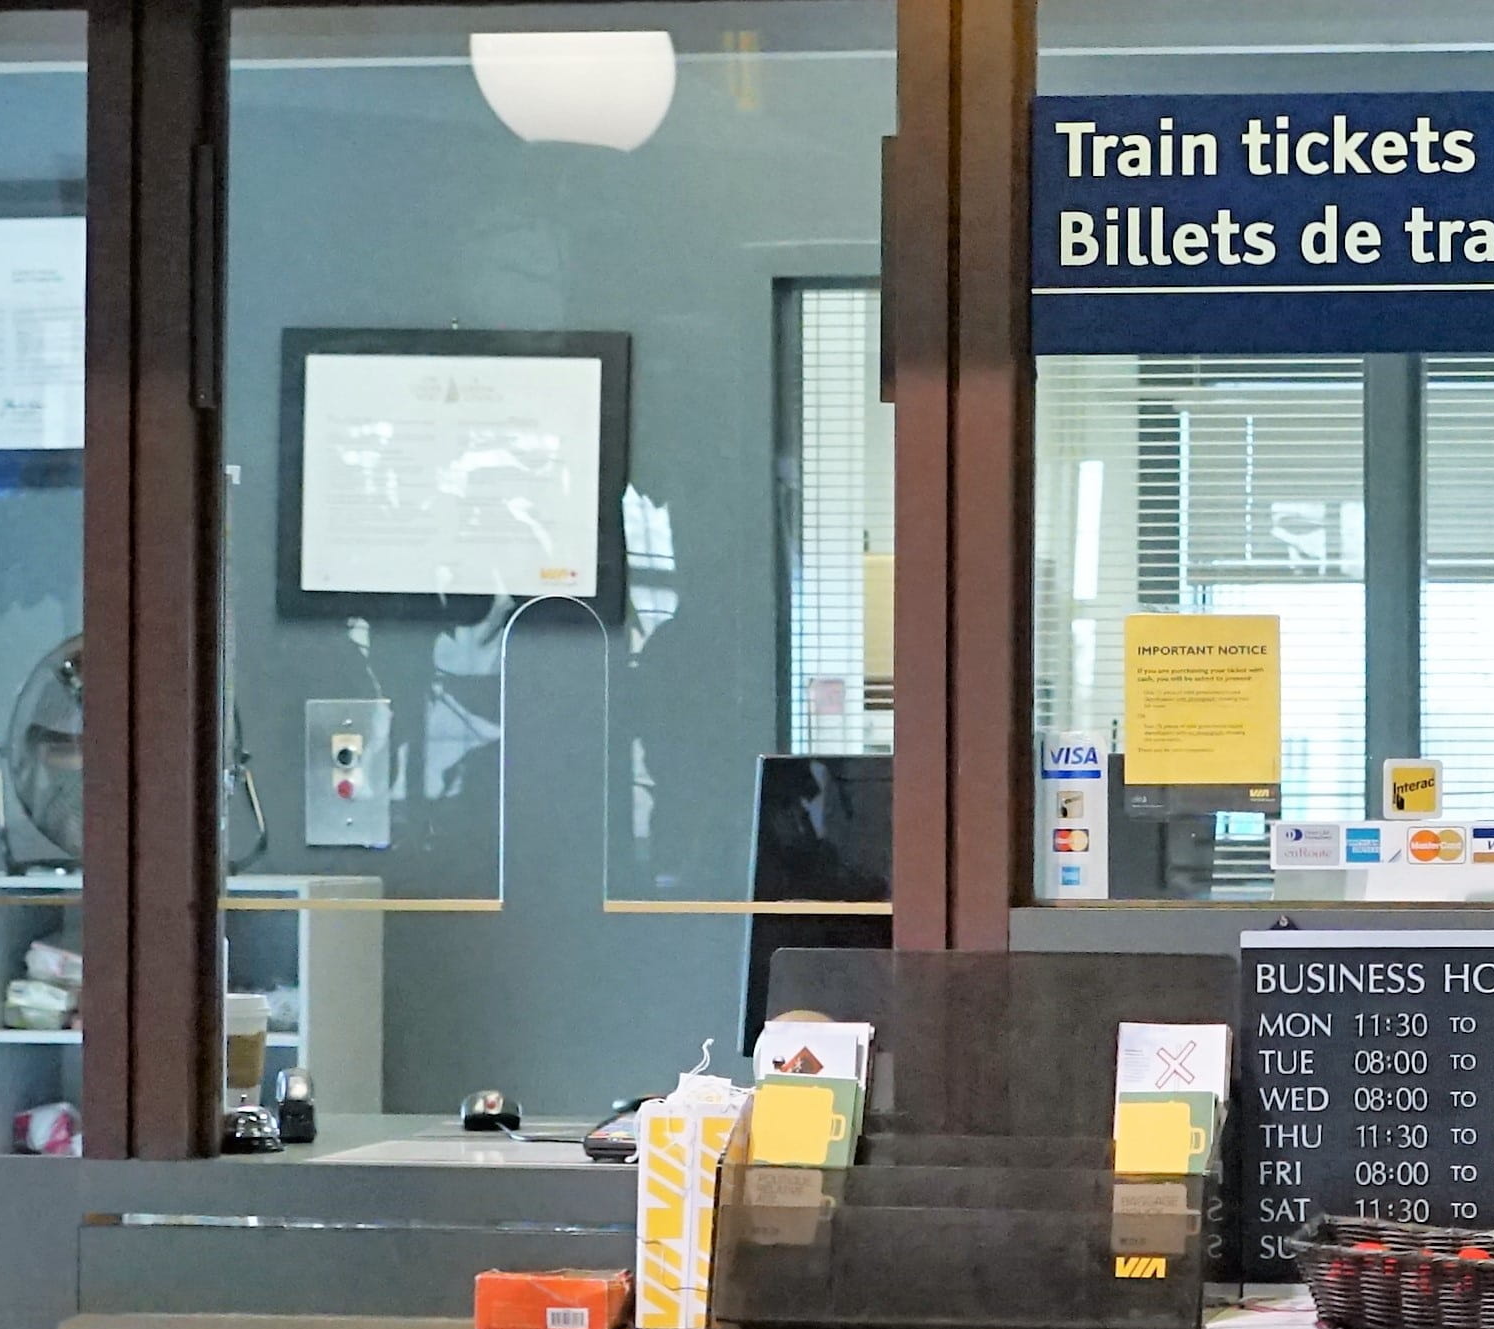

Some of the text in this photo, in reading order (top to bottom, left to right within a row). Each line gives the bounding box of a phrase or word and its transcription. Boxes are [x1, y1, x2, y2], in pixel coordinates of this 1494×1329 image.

[1056, 115, 1477, 177] Train tickets
[1059, 206, 1277, 267] Billets
[1301, 205, 1382, 265] de
[1137, 645, 1268, 656] IMPORTANT NOTICE
[1049, 747, 1099, 765] VISA
[1393, 776, 1435, 796] Interac
[1255, 963, 1426, 995] BUSINESS
[1258, 1012, 1333, 1038] MON
[1354, 1012, 1428, 1038] 11:30
[1450, 1016, 1477, 1034] TO
[1259, 1049, 1314, 1075] TUE
[1354, 1049, 1428, 1075] 08:00
[1450, 1053, 1477, 1071] TO
[1259, 1087, 1330, 1113] WED
[1353, 1087, 1428, 1113] 08:00
[1450, 1091, 1477, 1109] TO
[1259, 1124, 1324, 1150] THU
[1355, 1124, 1428, 1150] 11:30
[1450, 1128, 1477, 1146] TO
[1259, 1161, 1302, 1187] FRI
[1355, 1161, 1429, 1187] 08:00
[1450, 1165, 1477, 1183] TO
[1259, 1198, 1311, 1224] SAT
[1355, 1198, 1430, 1223] 11:30
[1450, 1202, 1477, 1220] TO
[1259, 1235, 1297, 1260] SU
[1114, 1257, 1167, 1278] VIA
